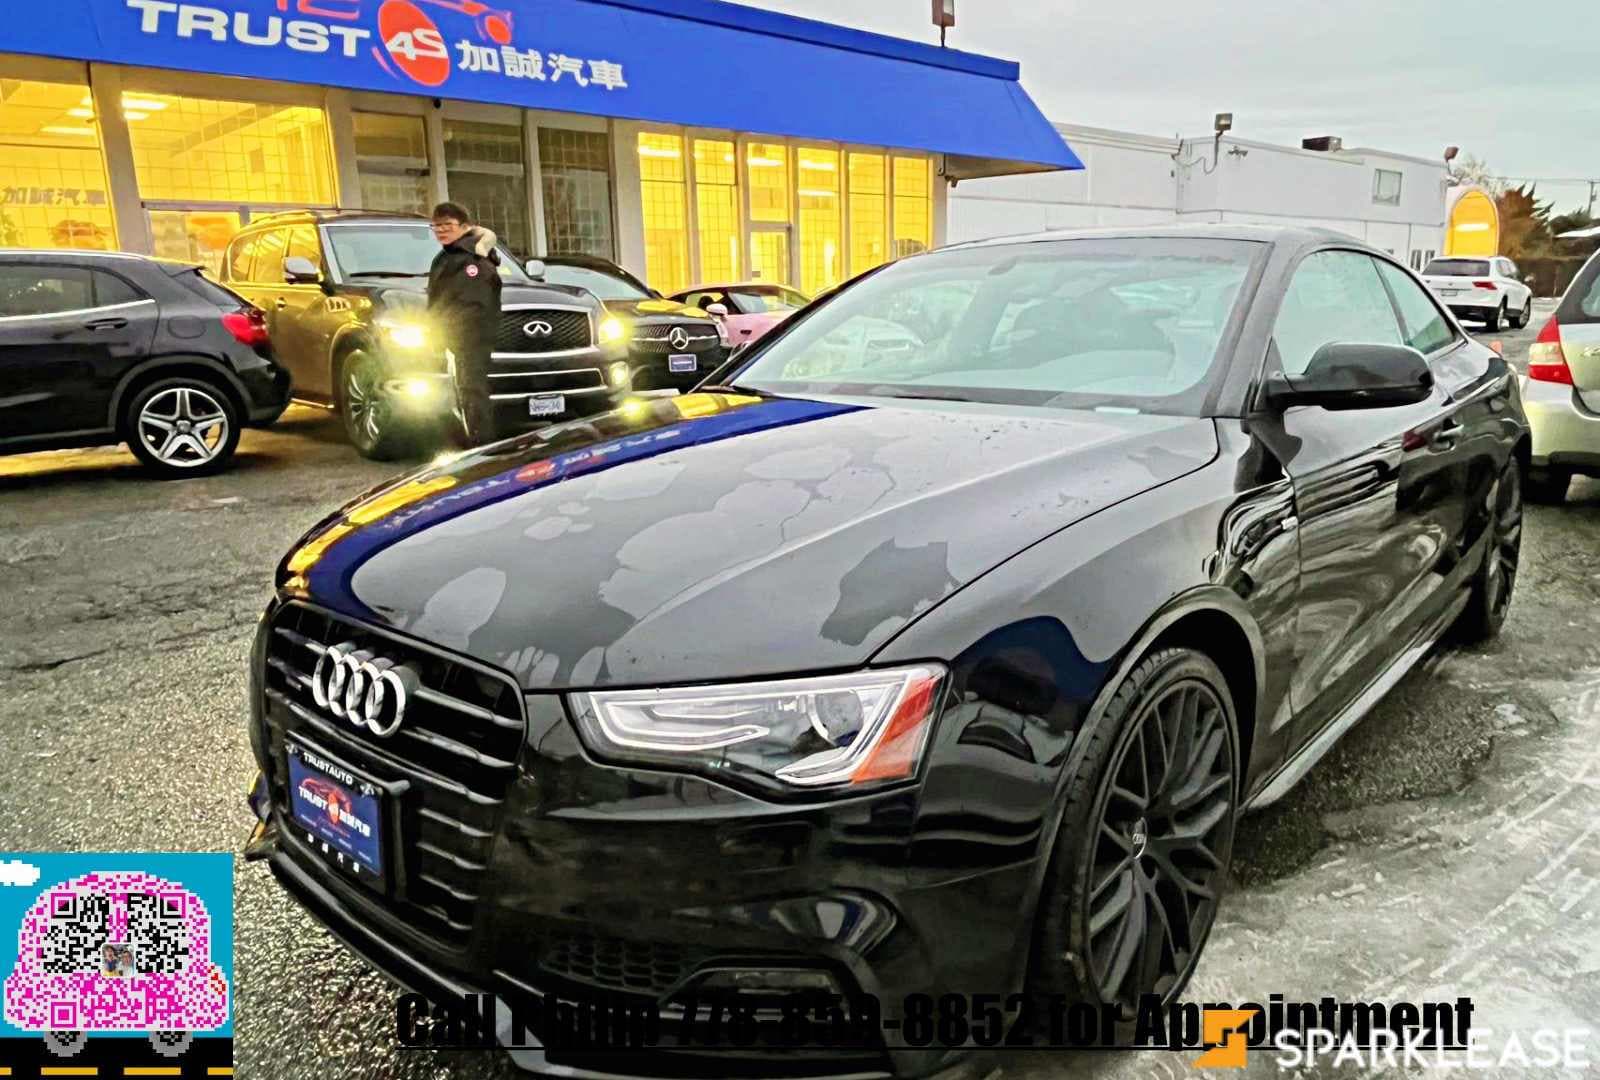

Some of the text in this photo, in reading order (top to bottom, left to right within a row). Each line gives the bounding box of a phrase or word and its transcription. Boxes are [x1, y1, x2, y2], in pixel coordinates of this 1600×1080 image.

[127, 0, 448, 60] TRUST 4S
[455, 39, 628, 90] 加誠汽車
